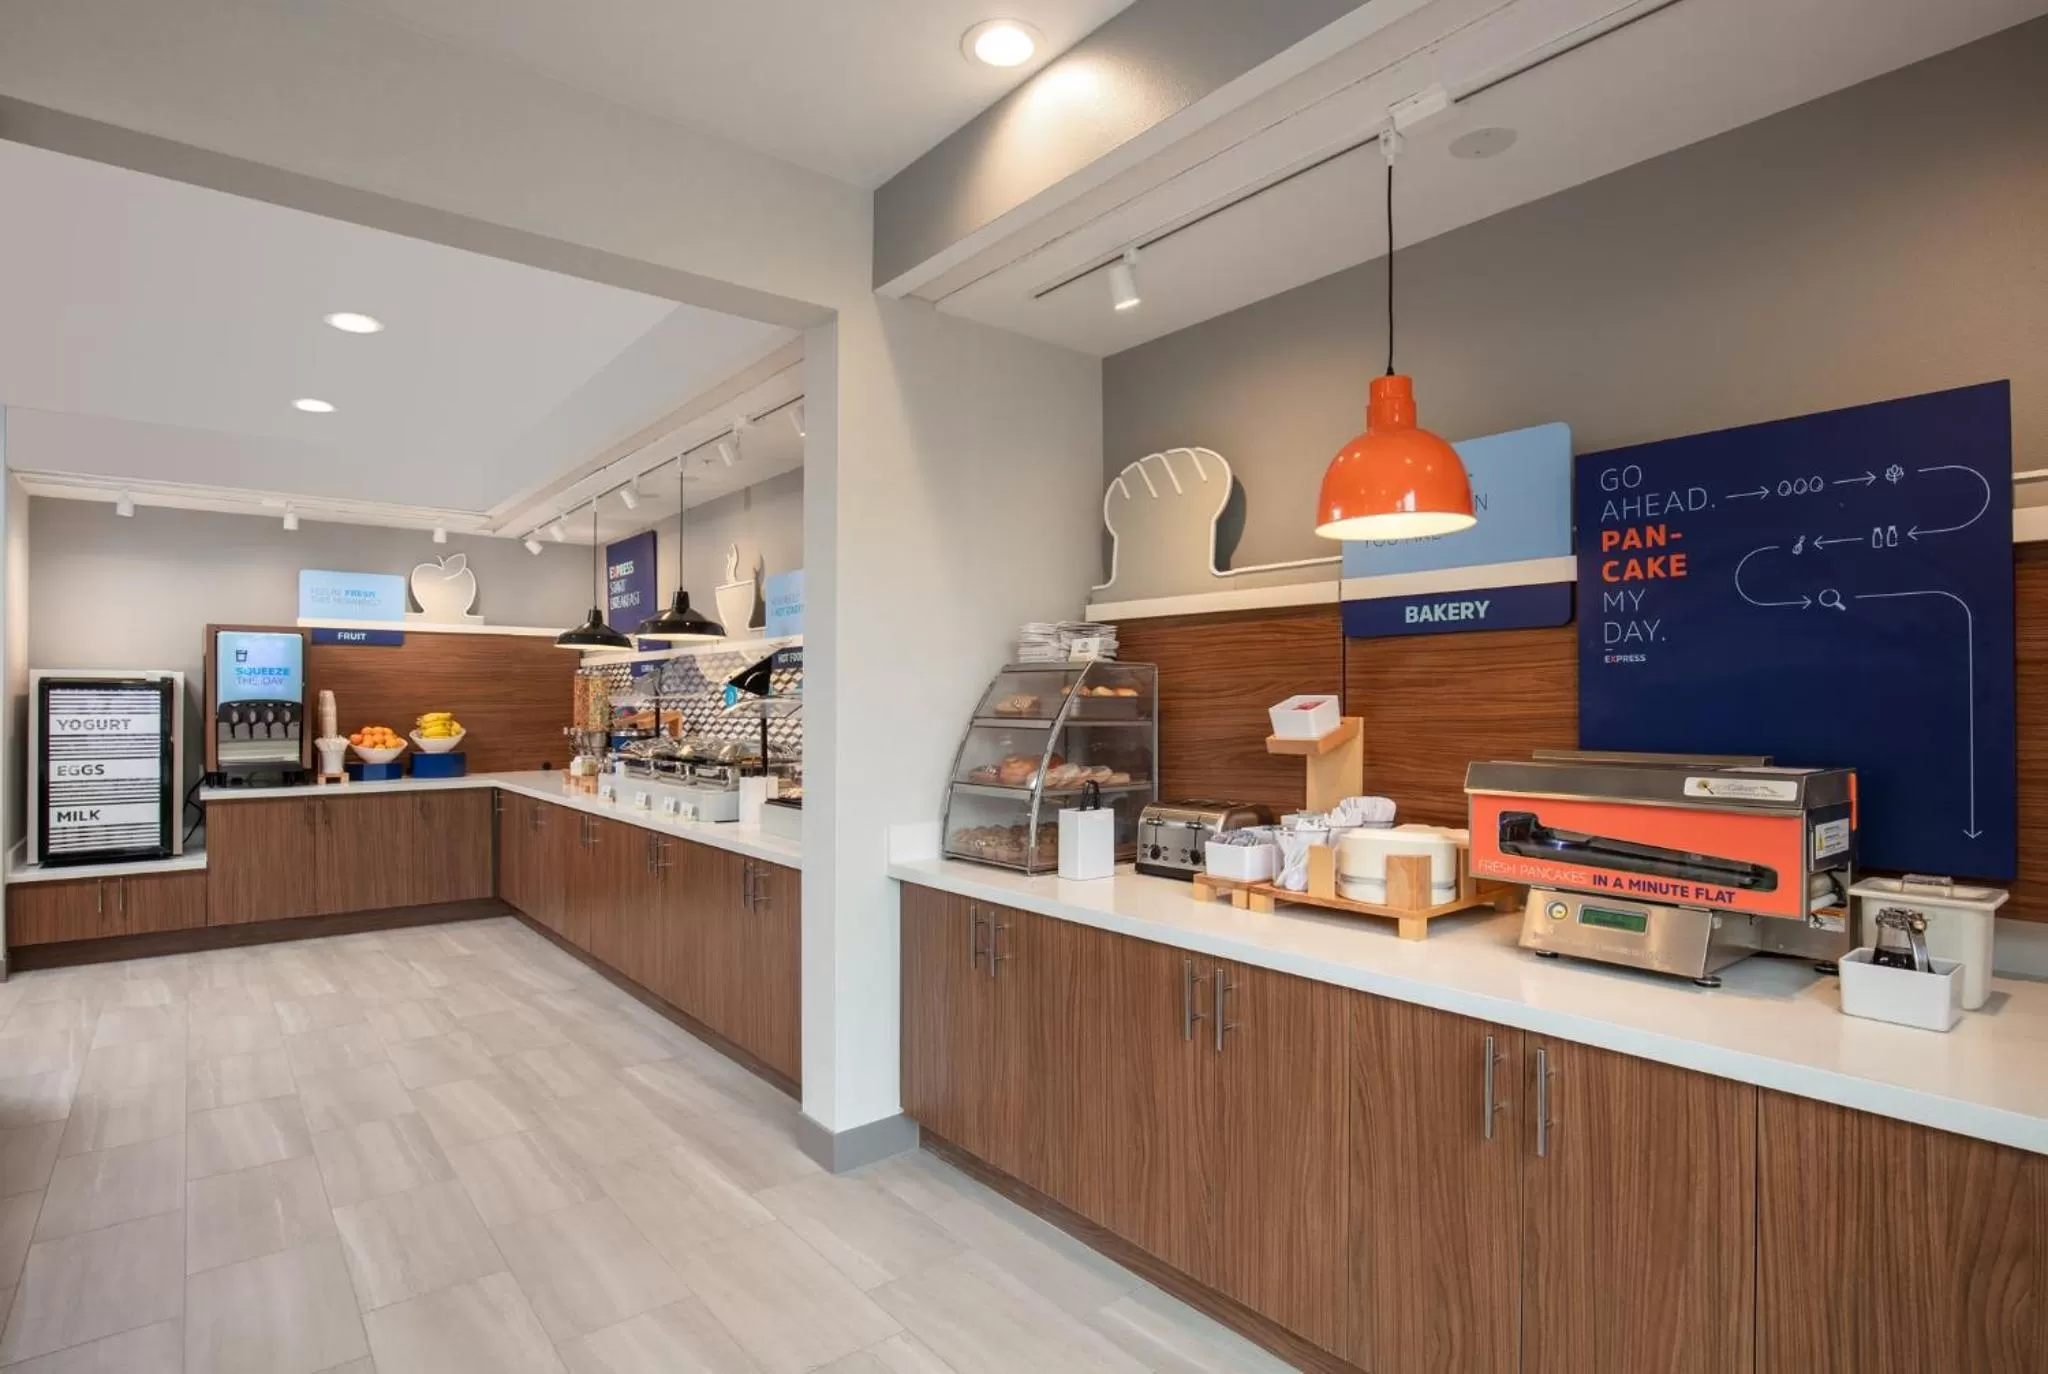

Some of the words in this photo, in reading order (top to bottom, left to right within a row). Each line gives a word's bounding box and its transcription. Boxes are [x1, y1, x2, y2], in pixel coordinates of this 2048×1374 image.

[1601, 465, 1642, 491] GO
[1601, 487, 1716, 522] AHEAD.
[1602, 524, 1683, 552] PAN-
[1602, 554, 1688, 583] CAKE
[1405, 600, 1491, 623] BAKERY
[1604, 588, 1646, 613] MY
[337, 632, 368, 641] FRUIT
[1604, 618, 1667, 644] DAY.
[1604, 653, 1647, 664] EXPRESS
[235, 667, 291, 677] SQUEEZE
[56, 718, 132, 731] YOGURT
[57, 763, 105, 777] EGGS
[57, 809, 101, 823] MILK
[1478, 859, 1516, 875] FRESH
[1520, 864, 1588, 885] PANCAKES
[1593, 874, 1608, 887] IN
[1612, 876, 1624, 889] A
[1628, 879, 1690, 898] MINUTE
[1695, 887, 1736, 903] FLAT
